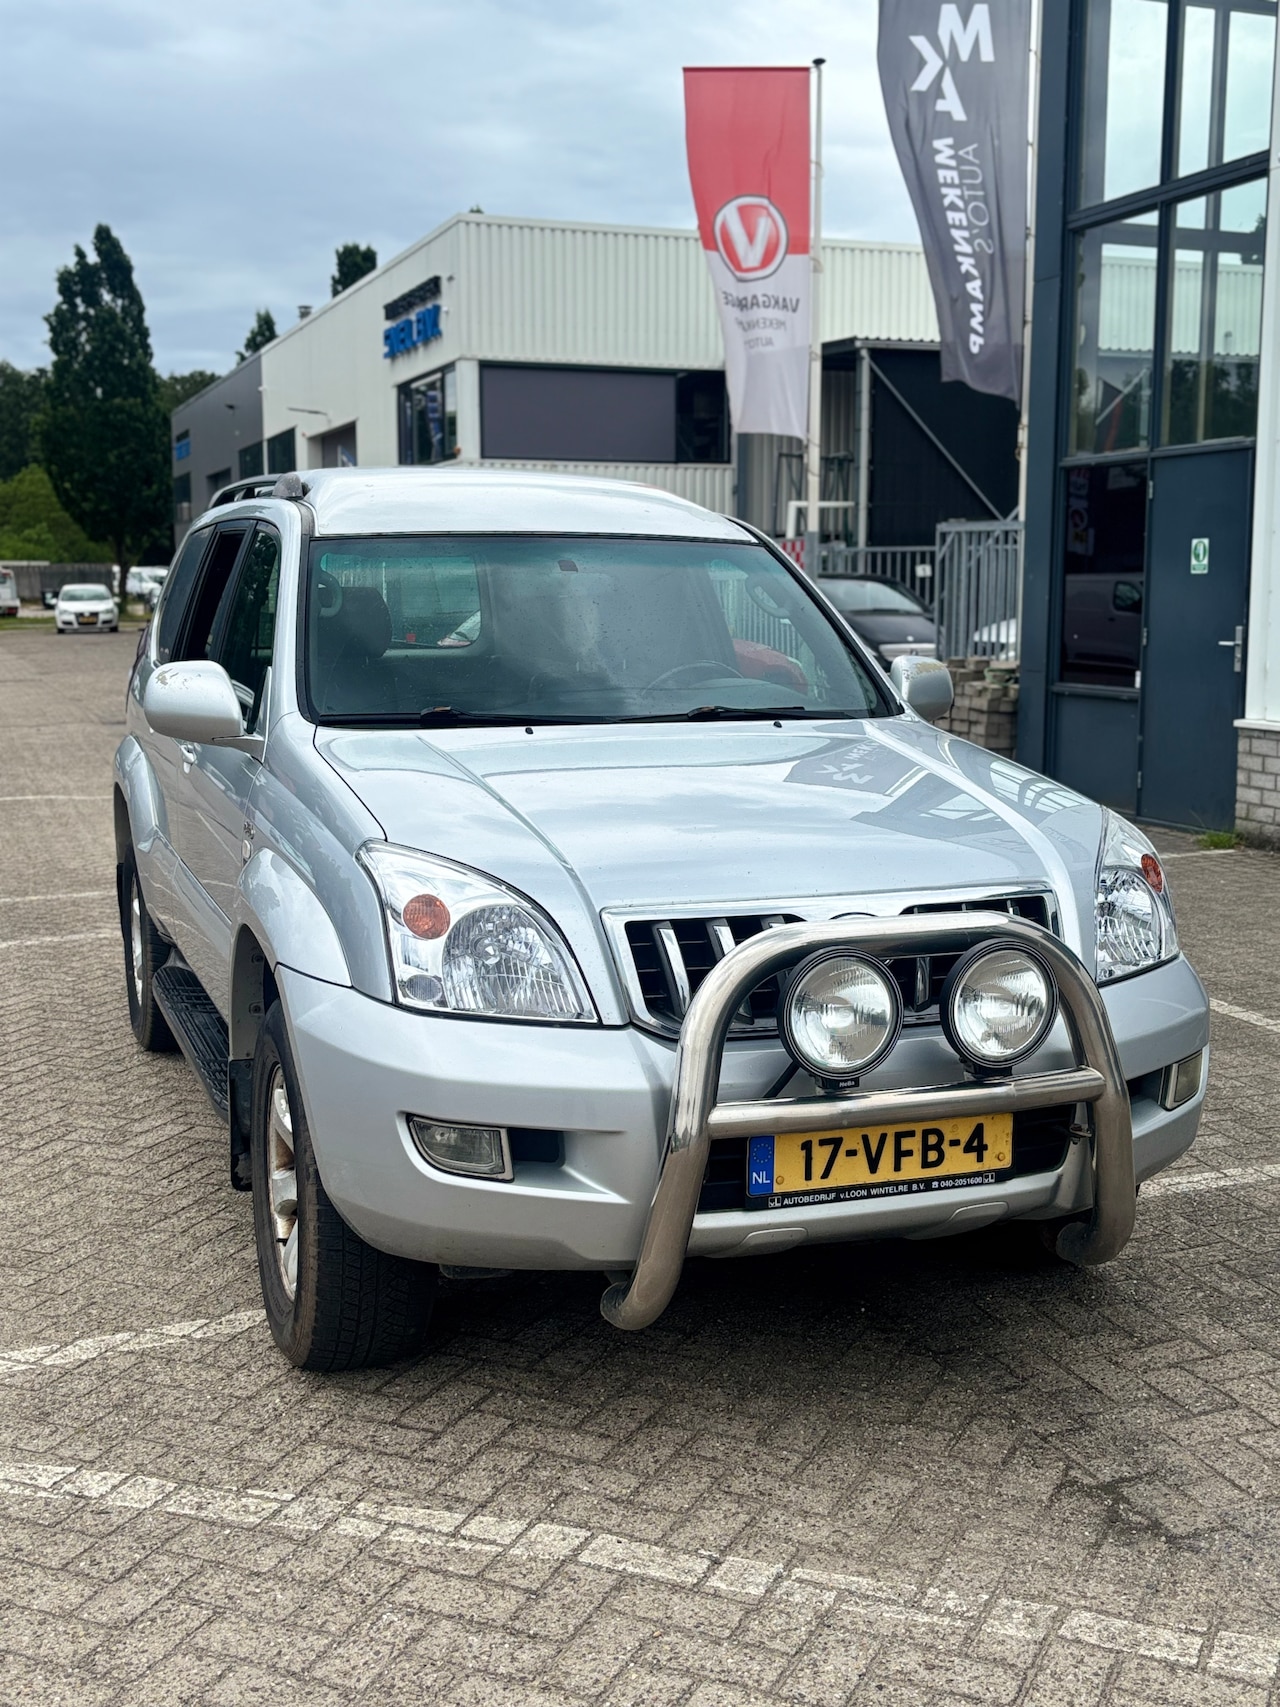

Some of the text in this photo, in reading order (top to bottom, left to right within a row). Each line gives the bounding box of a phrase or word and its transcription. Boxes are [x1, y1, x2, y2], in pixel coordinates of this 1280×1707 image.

[800, 1122, 989, 1182] 17-VFB-4
[752, 1170, 771, 1185] NL
[783, 1192, 837, 1206] AUTOBEDRIJF
[840, 1188, 868, 1199] v.LOON
[870, 1184, 909, 1196] WINTELRE
[912, 1182, 926, 1191] B.V.
